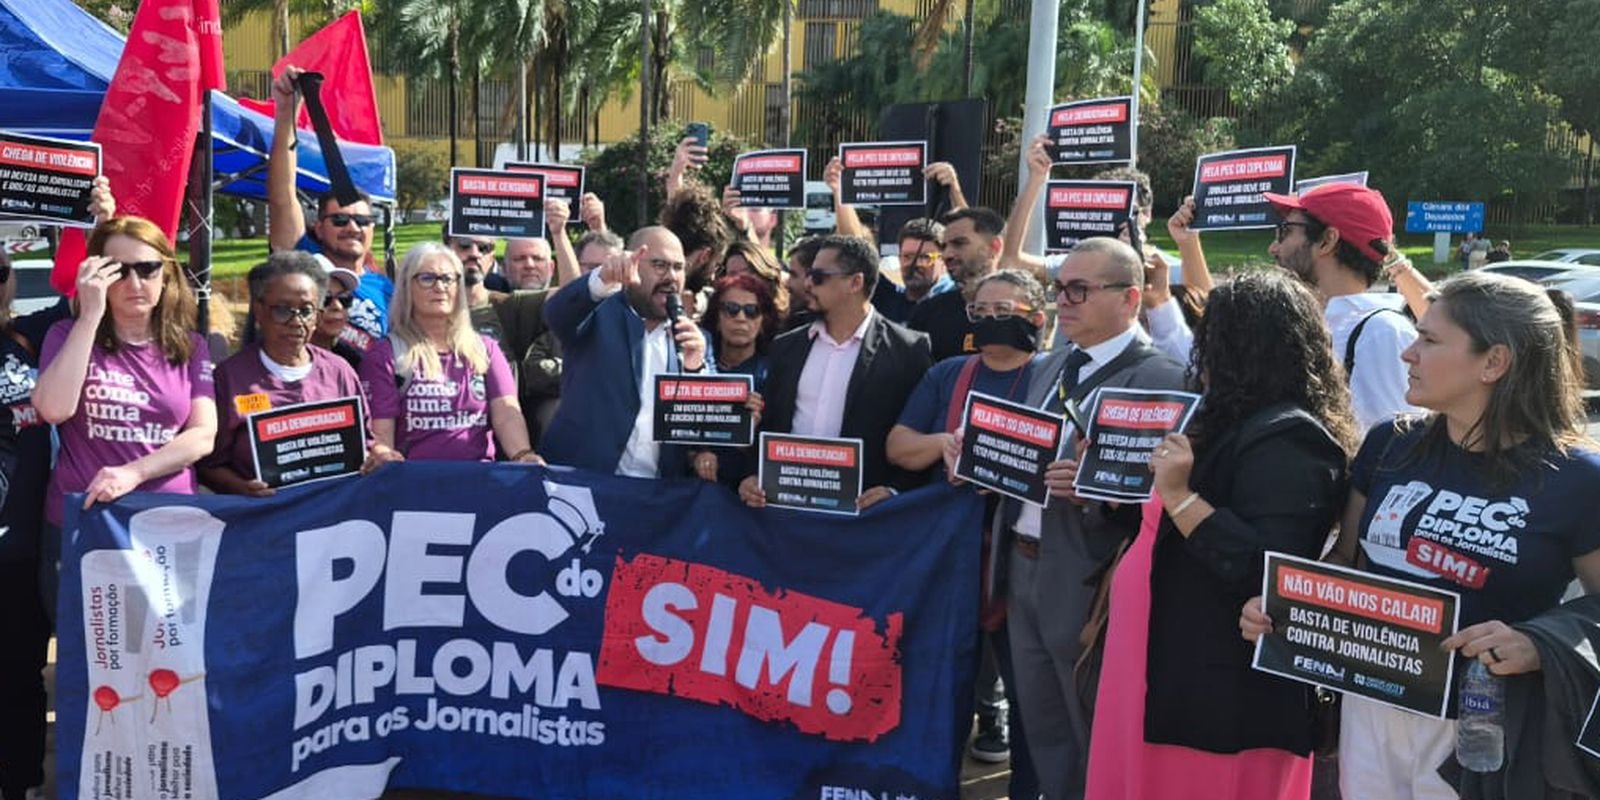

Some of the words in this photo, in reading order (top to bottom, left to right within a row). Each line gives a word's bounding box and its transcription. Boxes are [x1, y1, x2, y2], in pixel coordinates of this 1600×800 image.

[2, 146, 34, 161] CHEGA
[35, 151, 48, 164] DE
[50, 153, 94, 170] VIOLÊNCIA!
[1202, 166, 1220, 178] PELA
[1220, 164, 1235, 176] PEC
[1236, 163, 1246, 175] DO
[1246, 160, 1282, 174] DIPLOMA
[1053, 192, 1068, 202] PELA
[1069, 192, 1082, 203] PEC
[1093, 192, 1124, 204] DIPLOMA
[85, 384, 150, 405] como
[407, 398, 452, 412] uma
[692, 386, 703, 398] DE
[85, 402, 140, 421] uma
[266, 420, 289, 435] PELA
[289, 412, 346, 430] DEMOCRACIA!
[974, 408, 992, 424] PELA
[992, 414, 1006, 429] PEC
[1006, 417, 1018, 432] DO
[1018, 419, 1054, 441] DIPLOMA
[776, 444, 795, 457] PELA
[796, 447, 848, 461] DEMOCRACIA!
[1426, 489, 1520, 531] PEC
[1507, 514, 1526, 528] do
[1414, 528, 1440, 542] para
[1440, 536, 1452, 545] os
[1454, 538, 1518, 564] Jornalistas
[1417, 514, 1519, 554] DIPLOMA
[1416, 544, 1479, 582] SIM!
[294, 511, 576, 660] PEC
[555, 558, 604, 598] do
[1283, 574, 1313, 596] NÃO
[1316, 581, 1345, 604] VÃO
[1348, 590, 1378, 612] NOS
[1381, 597, 1438, 626] CALAR!
[90, 586, 109, 669] Jornalistas
[106, 583, 121, 646] formação
[1290, 607, 1330, 630] BASTA
[1333, 617, 1350, 635] DE
[1352, 622, 1420, 654] VIOLÊNCIA
[167, 623, 182, 646] por
[634, 582, 856, 716] SIM!
[1286, 626, 1335, 653] CONTRA
[1336, 640, 1424, 676] JORNALISTAS
[110, 646, 123, 670] por
[1293, 655, 1345, 681] FENAJ
[293, 638, 602, 730] DIPLOMA
[291, 715, 370, 772] para
[375, 706, 409, 737] os
[414, 698, 605, 746] Jornalistas
